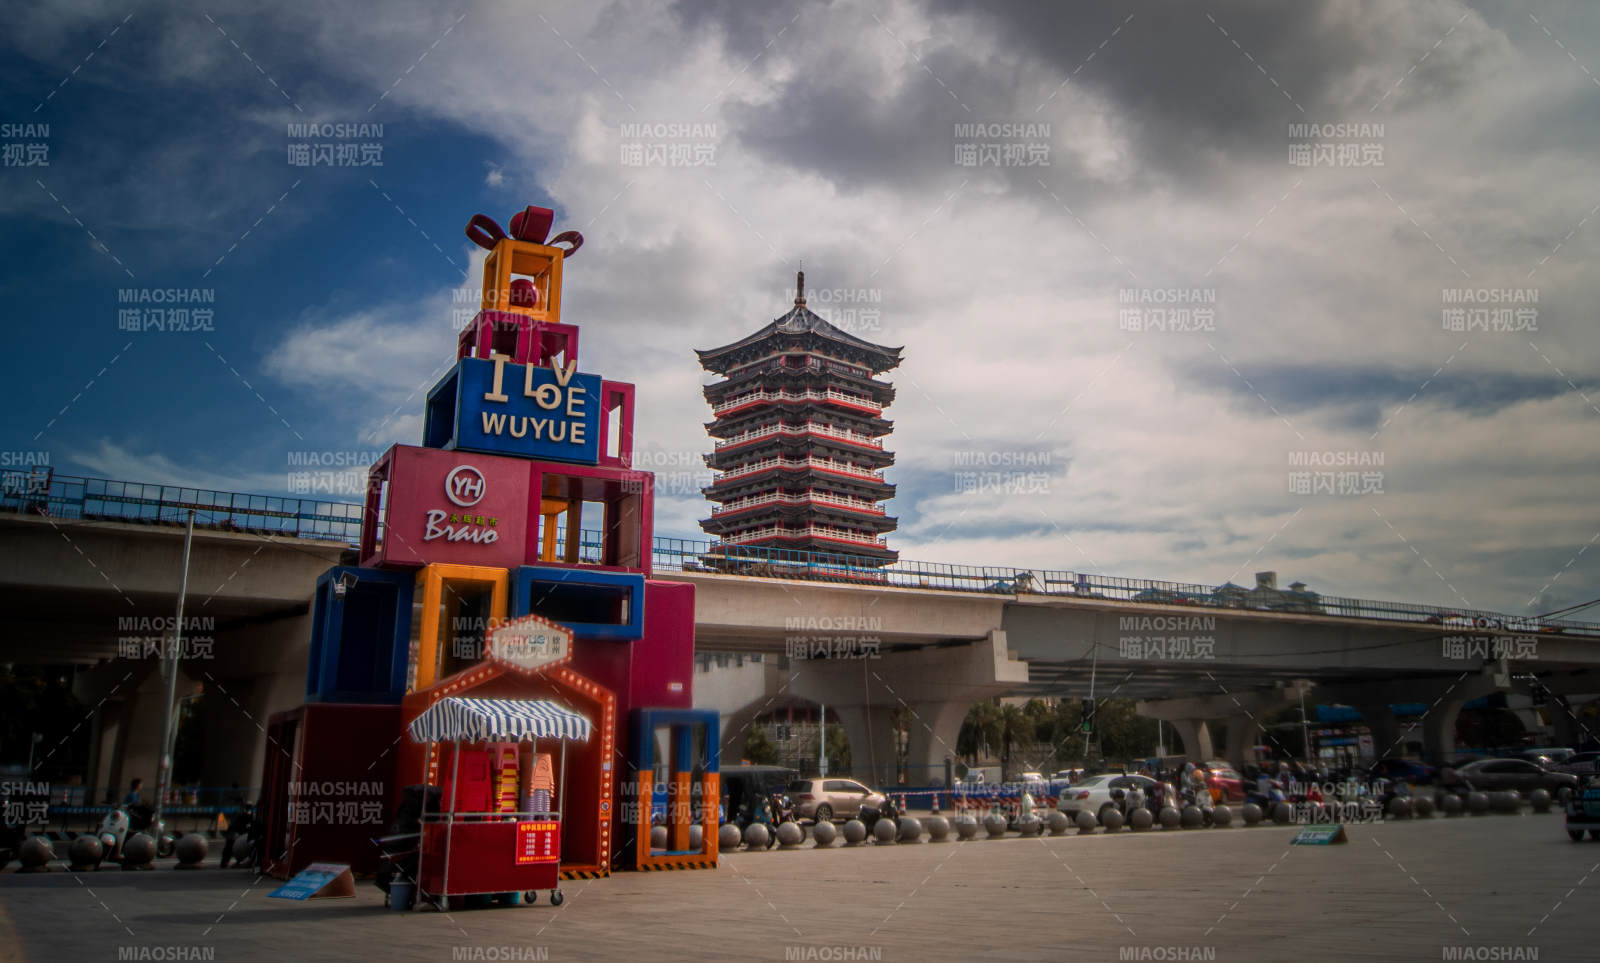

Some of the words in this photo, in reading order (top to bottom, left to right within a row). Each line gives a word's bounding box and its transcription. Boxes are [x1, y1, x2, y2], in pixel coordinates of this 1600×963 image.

[484, 353, 510, 403] I
[482, 411, 586, 444] WUYUE
[424, 509, 499, 544] Bravo
